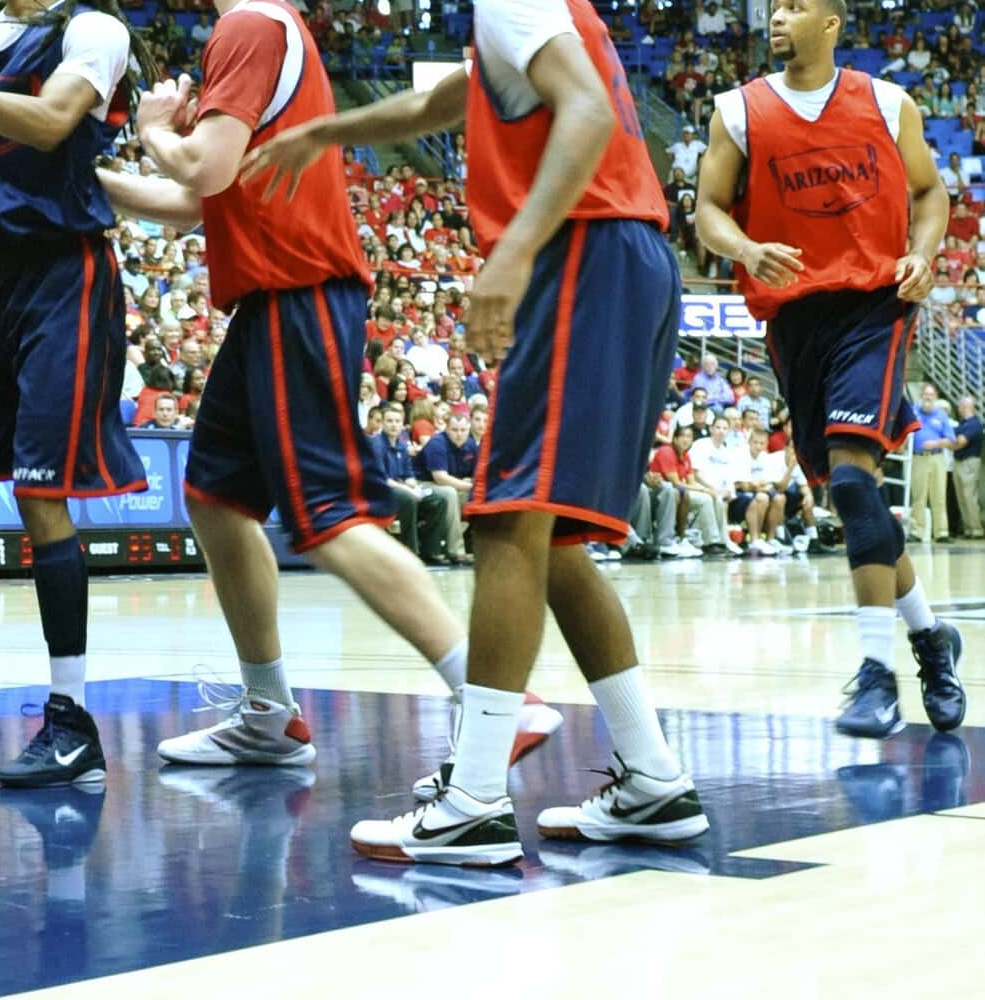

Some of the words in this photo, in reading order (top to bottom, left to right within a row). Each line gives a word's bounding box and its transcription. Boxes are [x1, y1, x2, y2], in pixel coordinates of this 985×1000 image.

[782, 162, 870, 193] ARIZONA
[828, 409, 876, 424] ATTACK
[118, 491, 165, 511] Power
